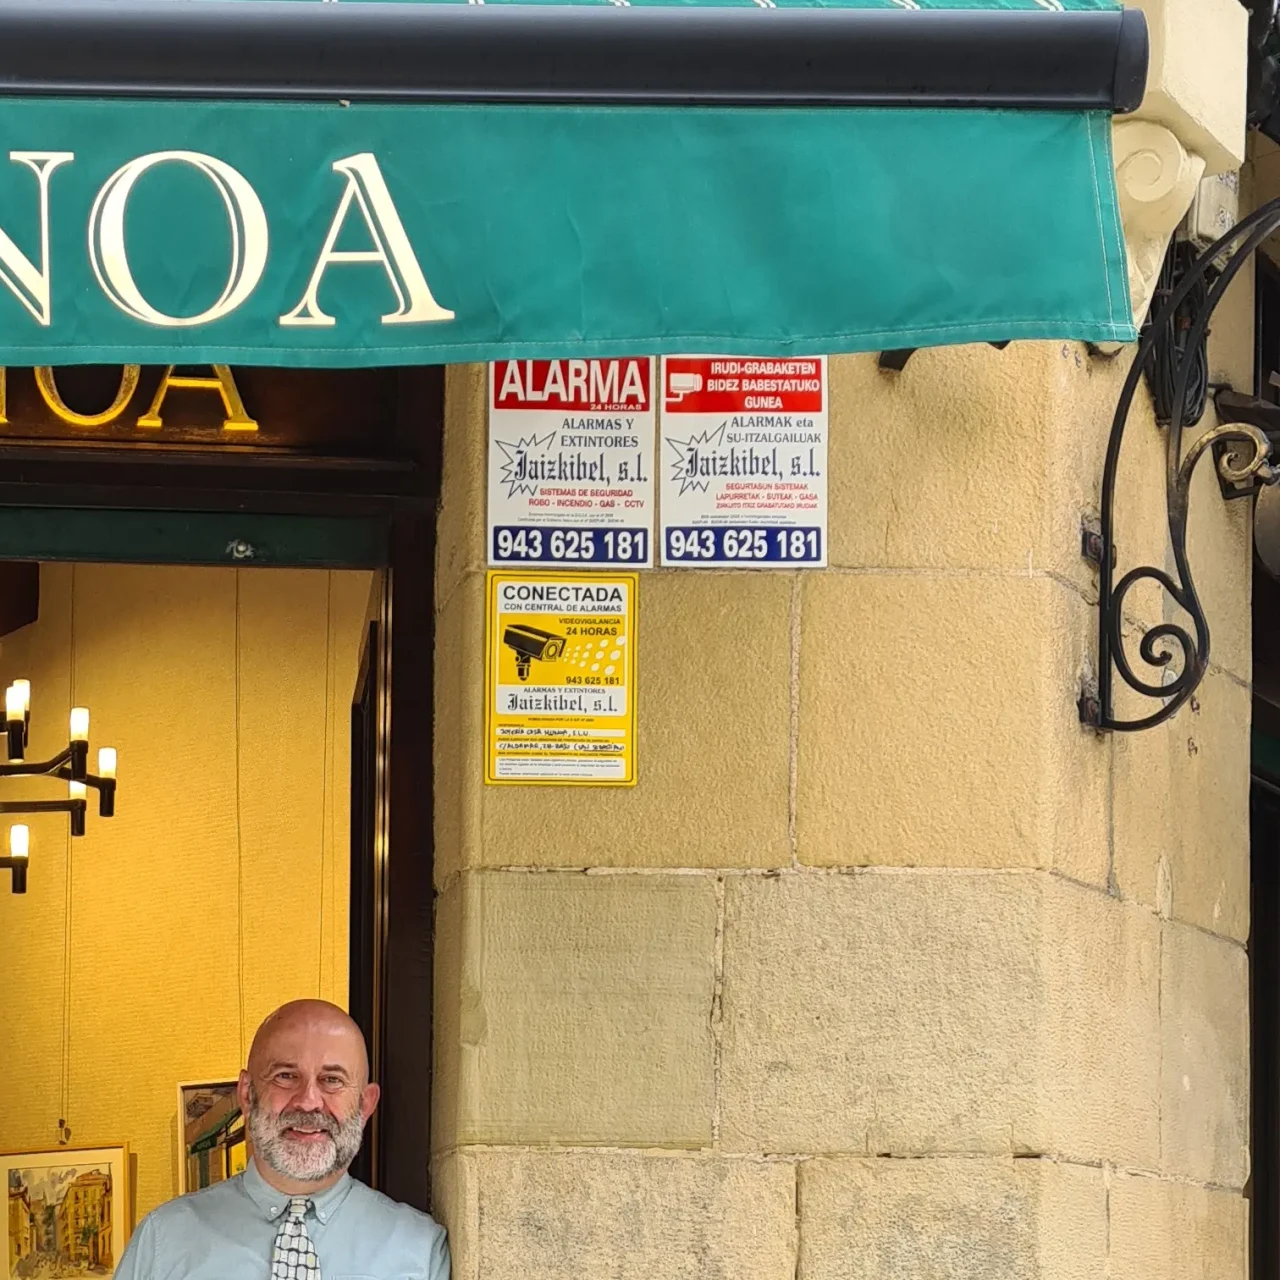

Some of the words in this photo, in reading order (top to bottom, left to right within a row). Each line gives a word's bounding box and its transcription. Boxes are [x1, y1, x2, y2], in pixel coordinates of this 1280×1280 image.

[711, 362, 816, 375] IRUDI-GRABAKETEN
[499, 358, 646, 403] ALARMA
[707, 379, 739, 392] BIDEZ
[742, 379, 820, 392] BABESTATUKO
[744, 396, 783, 409] GUNEA
[562, 418, 622, 430] ALARMAS
[626, 418, 634, 429] Y
[731, 416, 792, 428] ALARMAK
[796, 418, 814, 428] eta
[561, 435, 638, 447] EXTINTORES
[726, 433, 821, 443] SU-ITZALGAILUAK
[514, 450, 611, 486] Jaizkibel,
[618, 452, 648, 482] s.l.
[686, 446, 783, 481] Jaizkibel,
[790, 447, 820, 477] s.l.
[540, 488, 577, 496] SISTEMAS
[590, 489, 633, 497] SEGURIDAD
[600, 500, 615, 508] GAS
[497, 529, 542, 558] 943
[551, 530, 595, 559] 625
[604, 531, 644, 560] 181
[670, 529, 715, 558] 943
[723, 529, 768, 558] 625
[777, 530, 817, 558] 181
[503, 585, 623, 602] CONECTADA
[524, 603, 564, 611] CENTRAL
[579, 604, 622, 612] ALARMAS
[566, 627, 577, 635] 24
[580, 627, 617, 636] HORAS
[566, 676, 582, 685] 943
[585, 676, 601, 685] 625
[604, 677, 620, 685] 181
